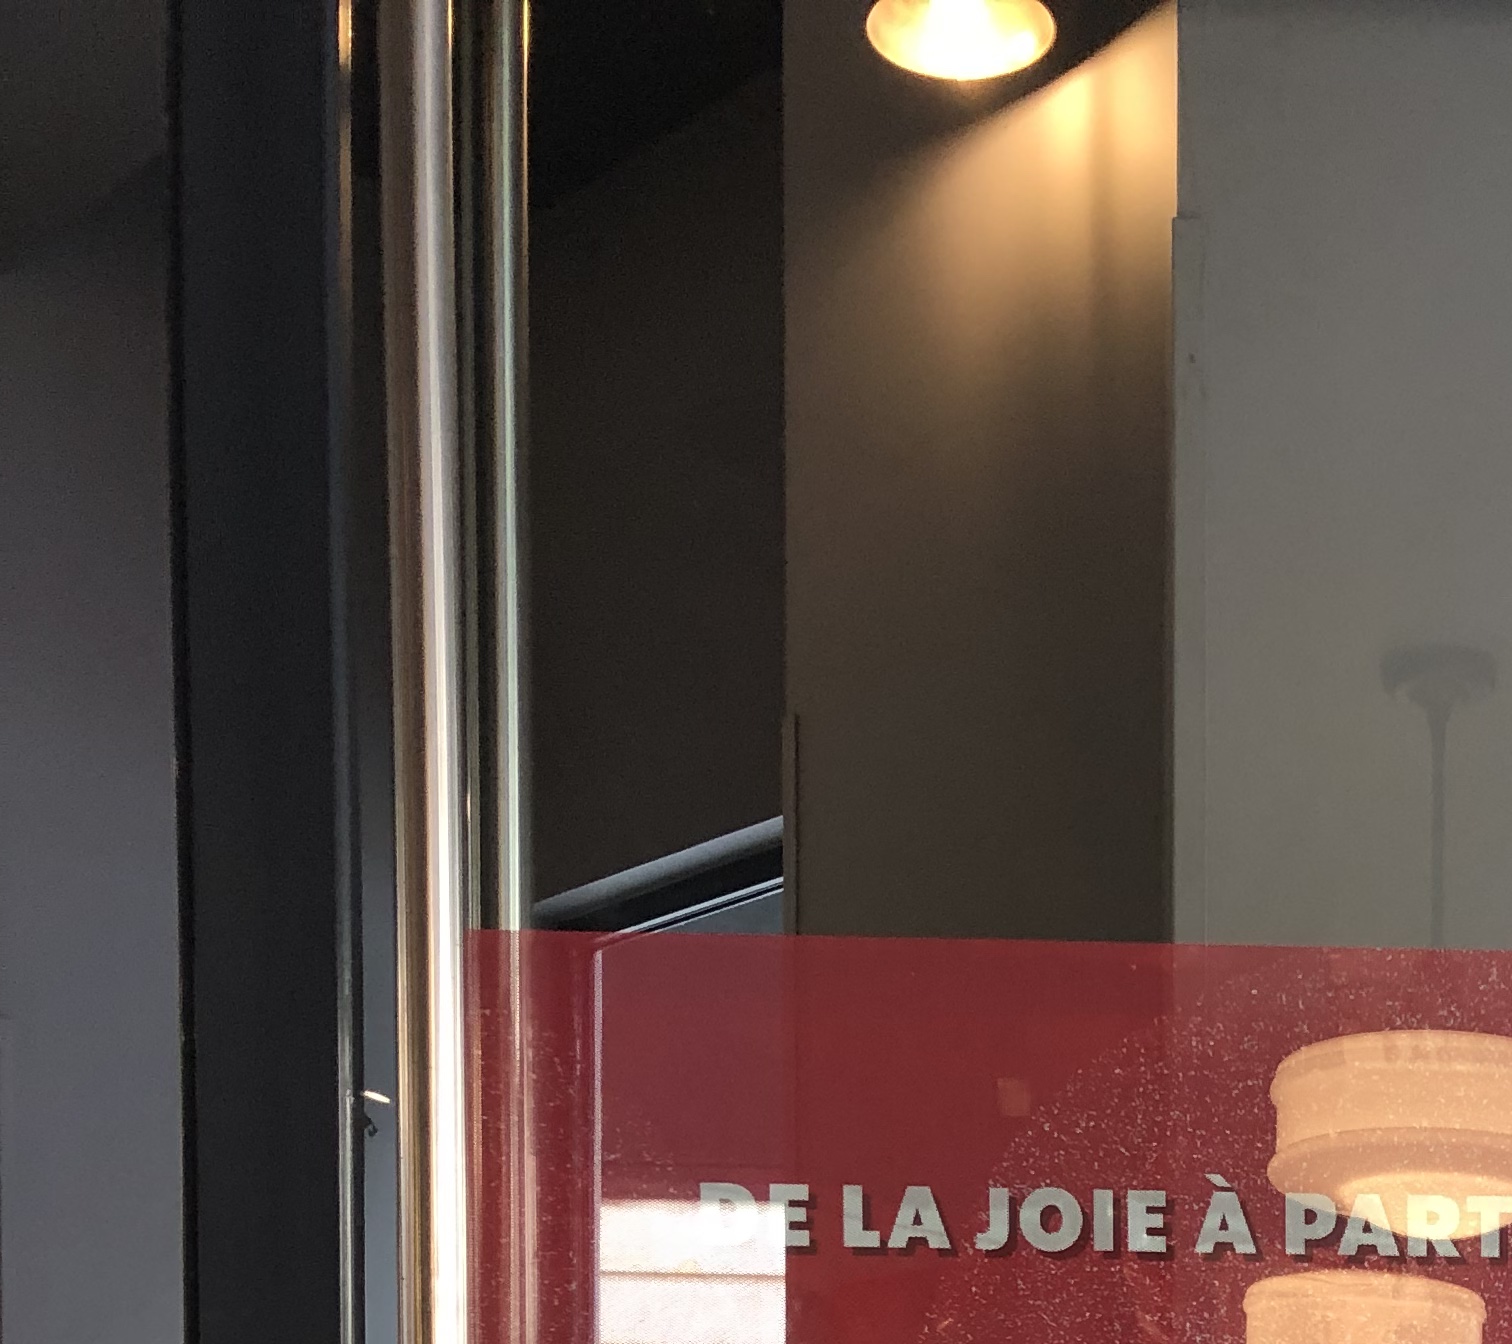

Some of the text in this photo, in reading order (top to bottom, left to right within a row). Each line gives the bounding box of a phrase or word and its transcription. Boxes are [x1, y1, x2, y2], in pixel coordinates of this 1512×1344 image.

[842, 1184, 952, 1250] LA
[974, 1187, 1170, 1254] JOIE
[1195, 1173, 1258, 1255] À
